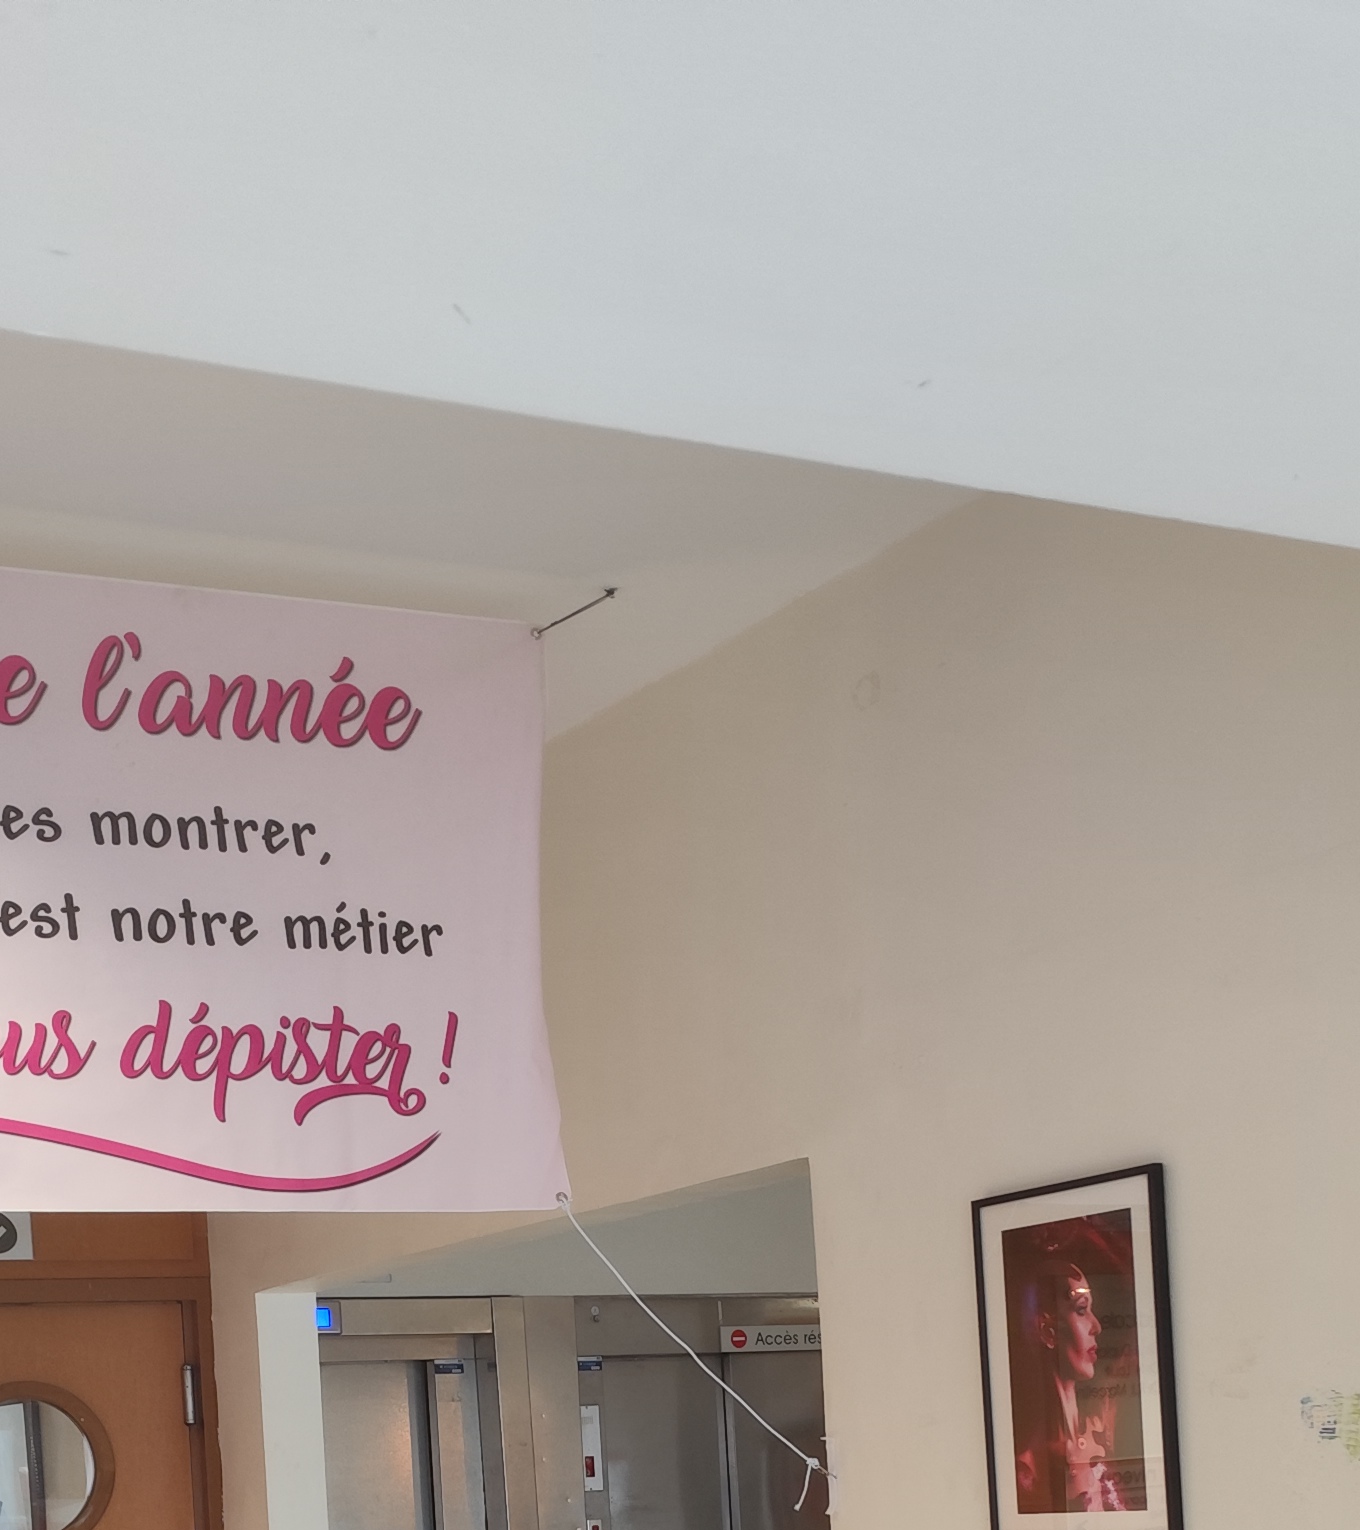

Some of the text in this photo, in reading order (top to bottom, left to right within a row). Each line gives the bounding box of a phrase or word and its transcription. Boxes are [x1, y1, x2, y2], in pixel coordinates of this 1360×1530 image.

[81, 630, 423, 751] l'année
[91, 804, 332, 865] montrer,
[111, 900, 258, 946] notre
[284, 901, 444, 957] métier
[119, 1000, 427, 1126] dépister
[755, 1330, 799, 1346] Accès
